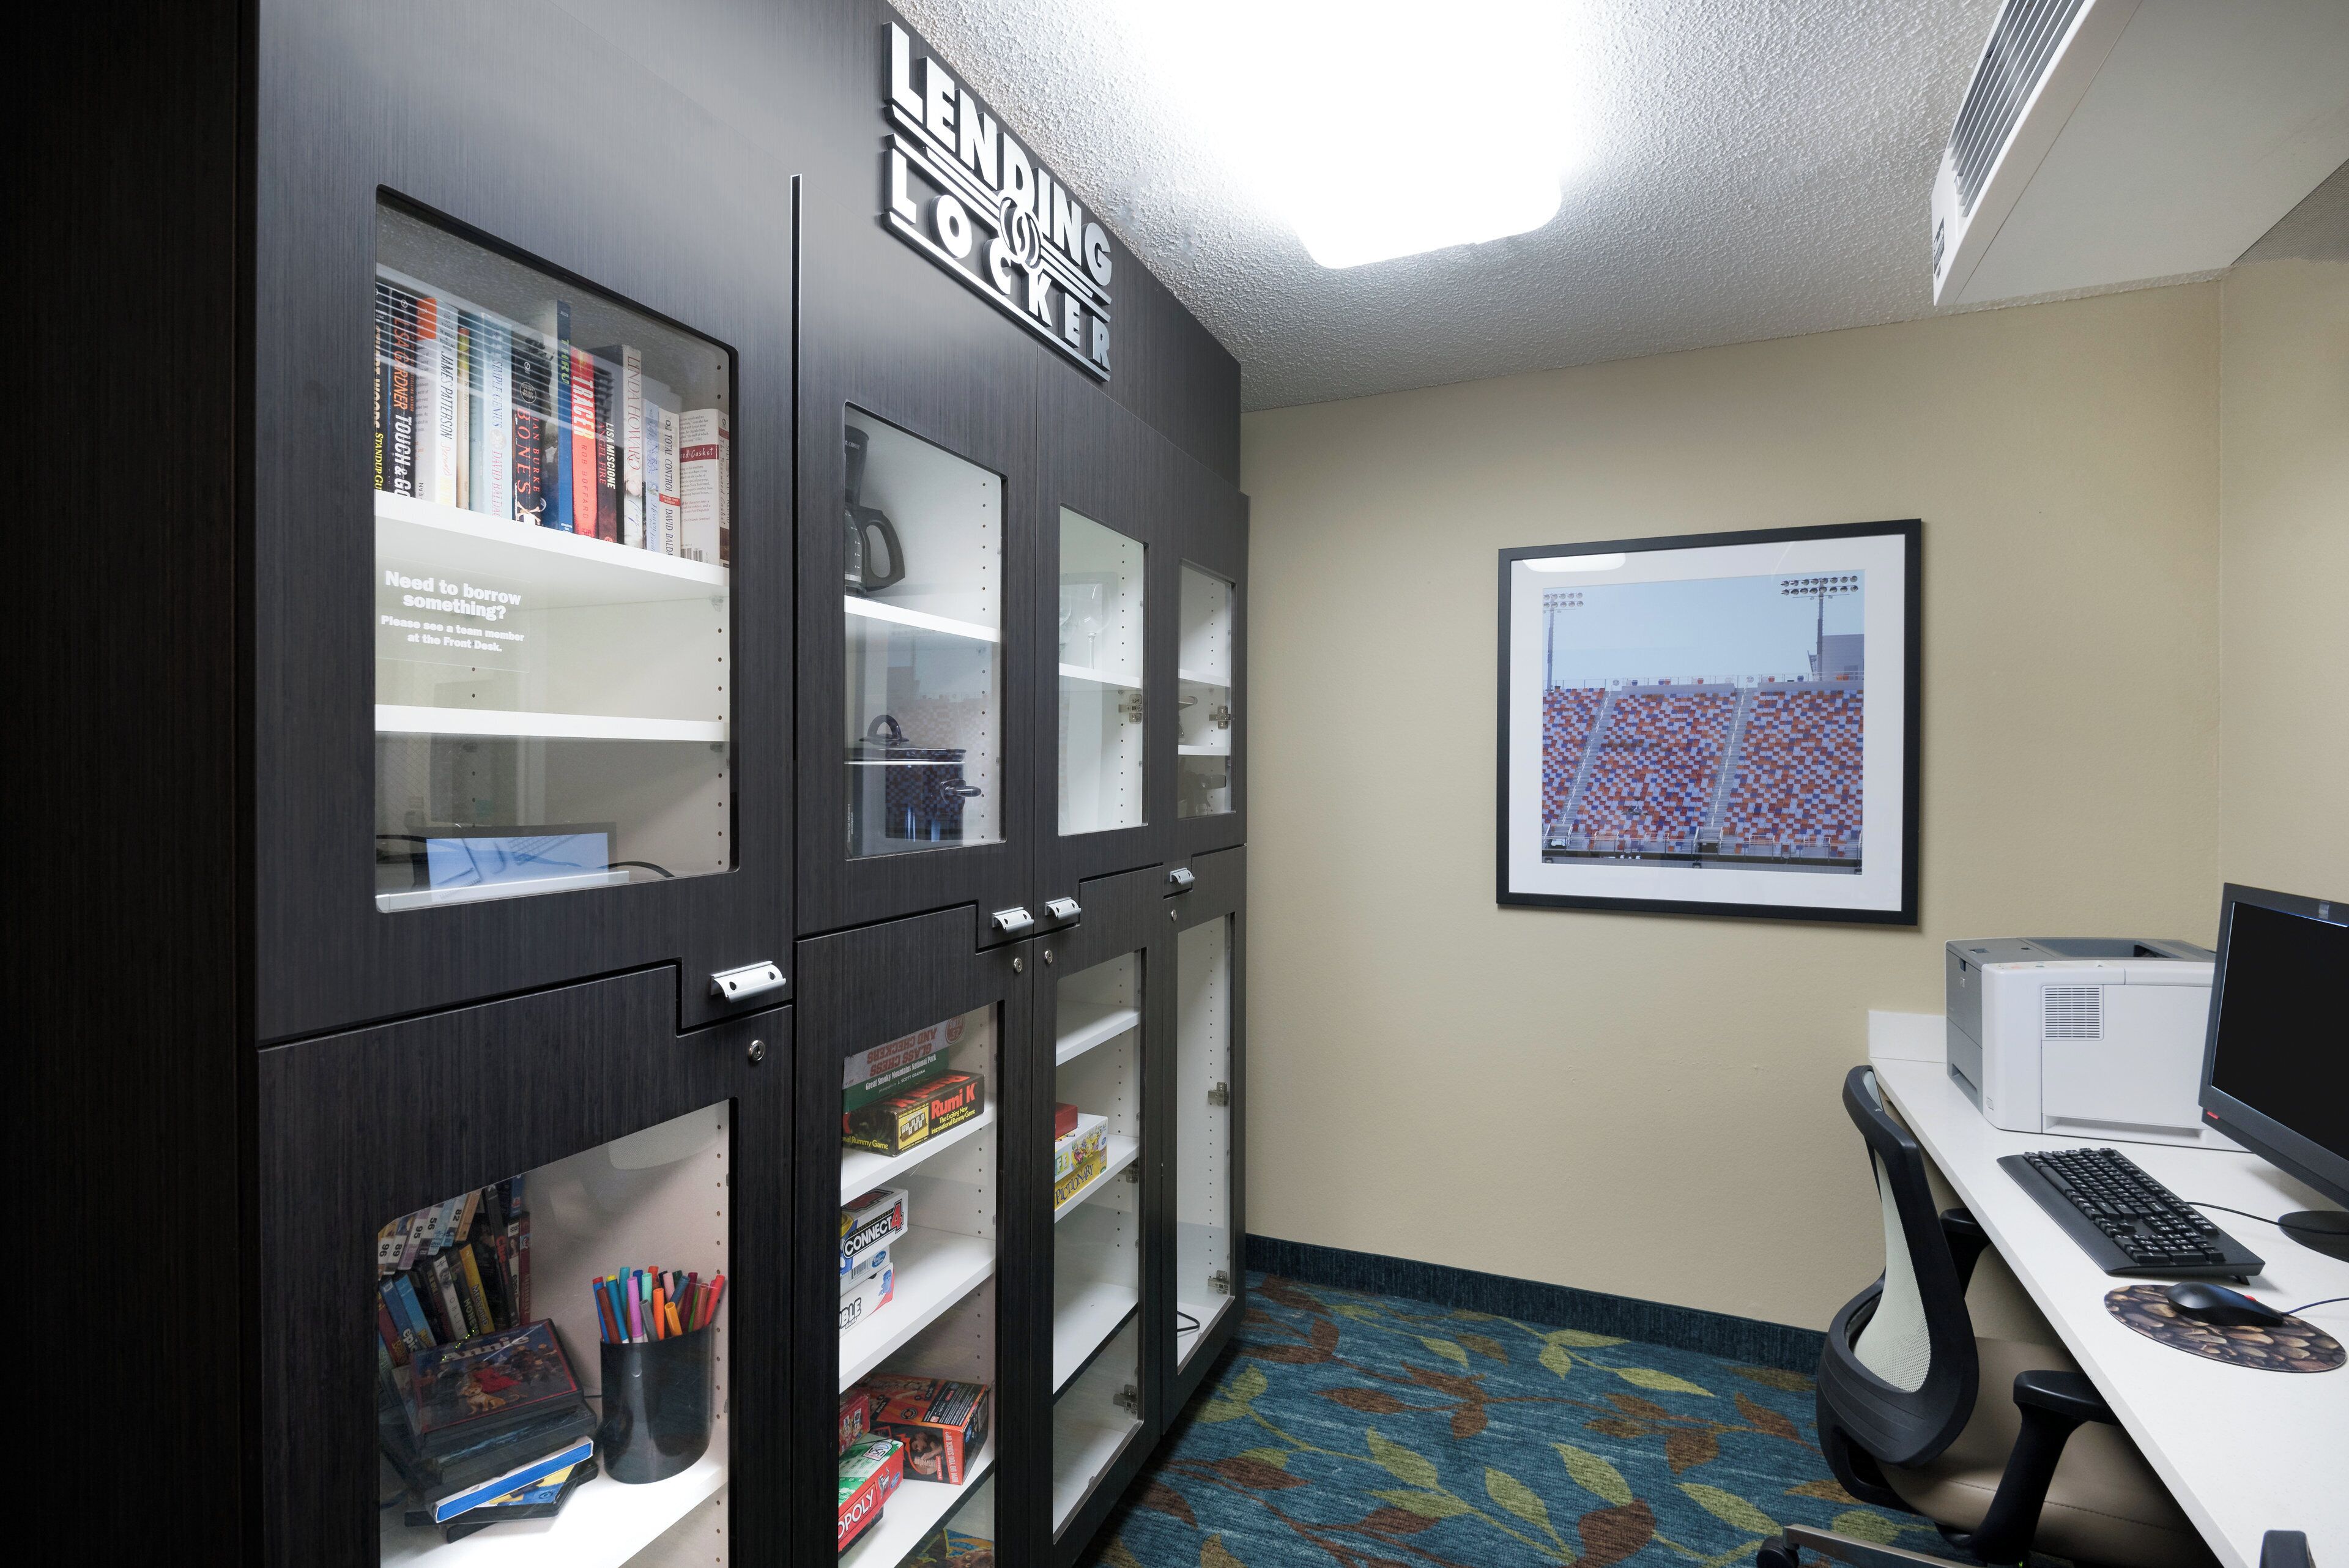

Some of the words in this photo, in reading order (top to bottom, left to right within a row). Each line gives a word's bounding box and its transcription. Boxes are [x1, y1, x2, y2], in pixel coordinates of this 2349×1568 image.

[883, 21, 1112, 287] LENDING
[884, 148, 1111, 372] LOCKER
[393, 318, 410, 347] LISA
[393, 351, 410, 411] GARDNER
[441, 351, 454, 387] JAMES
[491, 359, 503, 393] SIMPLE
[628, 356, 640, 400] LINDA
[440, 385, 454, 440] PATTERSON
[491, 393, 503, 428] GENIUS
[573, 375, 595, 440] TRACER
[395, 414, 412, 466] TOUCH
[517, 408, 531, 494] BONES
[597, 422, 606, 460] ANGEL
[627, 405, 641, 470] HOWARD
[374, 432, 384, 474] STANDUP
[492, 450, 502, 481] DAVID
[606, 445, 616, 489] MISCIONE
[691, 447, 714, 458] Casket
[394, 466, 408, 475] &
[385, 570, 434, 593] Need
[439, 579, 459, 596] to
[463, 583, 522, 606] borrow
[403, 593, 507, 622] something?
[380, 615, 421, 630] Please
[423, 621, 444, 632] see
[456, 625, 483, 637] team
[484, 629, 525, 642] member
[407, 633, 420, 643] at
[421, 634, 441, 645] the
[443, 636, 472, 648] Front
[473, 640, 503, 652] Desk.
[867, 1034, 916, 1064] CHECKERS
[917, 1027, 938, 1045] AND
[869, 1056, 901, 1077] CHESS
[902, 1042, 932, 1065] GLASS
[865, 1078, 877, 1091] Great
[877, 1072, 891, 1087] Smoky
[891, 1065, 912, 1080] Mountains
[911, 1058, 927, 1071] National
[927, 1053, 937, 1065] Park
[900, 1076, 911, 1084] SCOTT
[911, 1069, 926, 1079] GRAHAM
[930, 1088, 963, 1120] Rumi
[966, 1083, 977, 1104] K
[946, 1110, 960, 1123] Exciting
[959, 1105, 968, 1115] New
[930, 1118, 952, 1134] International
[951, 1113, 967, 1127] Rummy
[965, 1109, 976, 1120] Game
[852, 1135, 872, 1148] Rummy
[871, 1139, 889, 1150] Game
[1055, 1164, 1094, 1206] PICTIONARY
[428, 1217, 437, 1230] 56
[452, 1209, 462, 1222] 82
[844, 1215, 892, 1256] CONNECT
[891, 1203, 902, 1230] 4
[414, 1225, 423, 1239] 95
[379, 1243, 390, 1258] 96
[392, 1244, 403, 1257] 89
[472, 1282, 489, 1327] MEGAMIND
[403, 1328, 418, 1353] epic
[440, 1336, 530, 1364] Annie
[867, 1447, 886, 1457] USA
[946, 1442, 955, 1456] STACK
[950, 1472, 959, 1483] HOW
